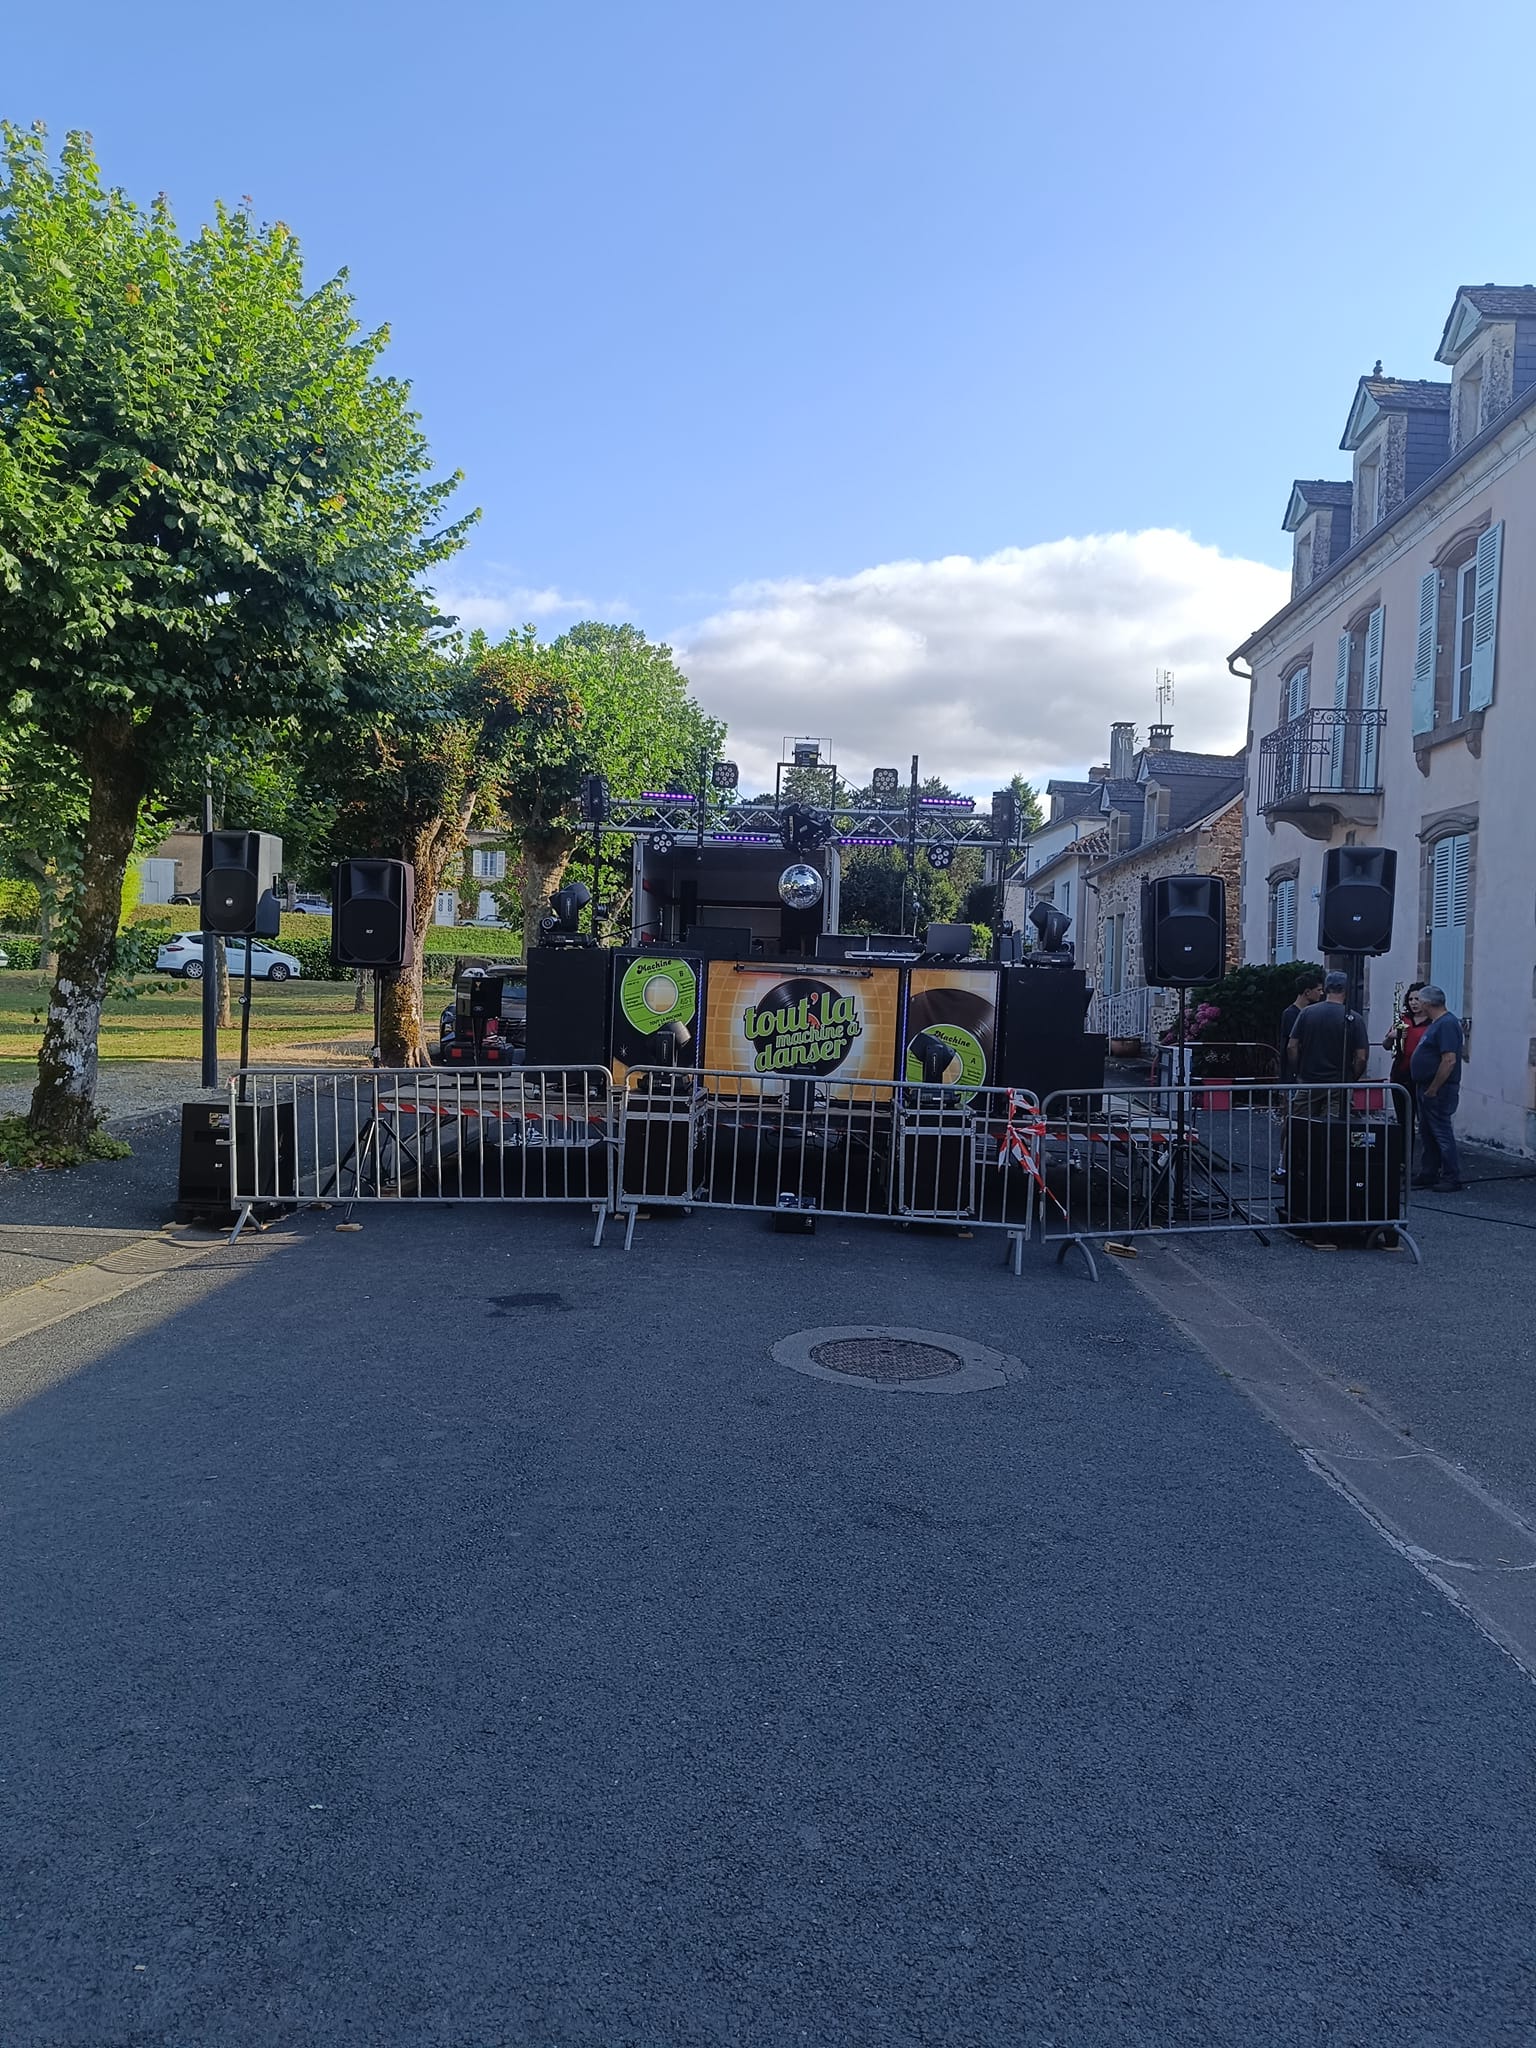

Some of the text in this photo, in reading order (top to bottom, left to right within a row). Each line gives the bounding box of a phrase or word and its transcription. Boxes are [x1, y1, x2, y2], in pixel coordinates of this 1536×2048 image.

[636, 960, 672, 974] Machine
[776, 1023, 844, 1048] machine
[934, 1030, 971, 1048] Machine
[755, 1038, 848, 1072] danser
